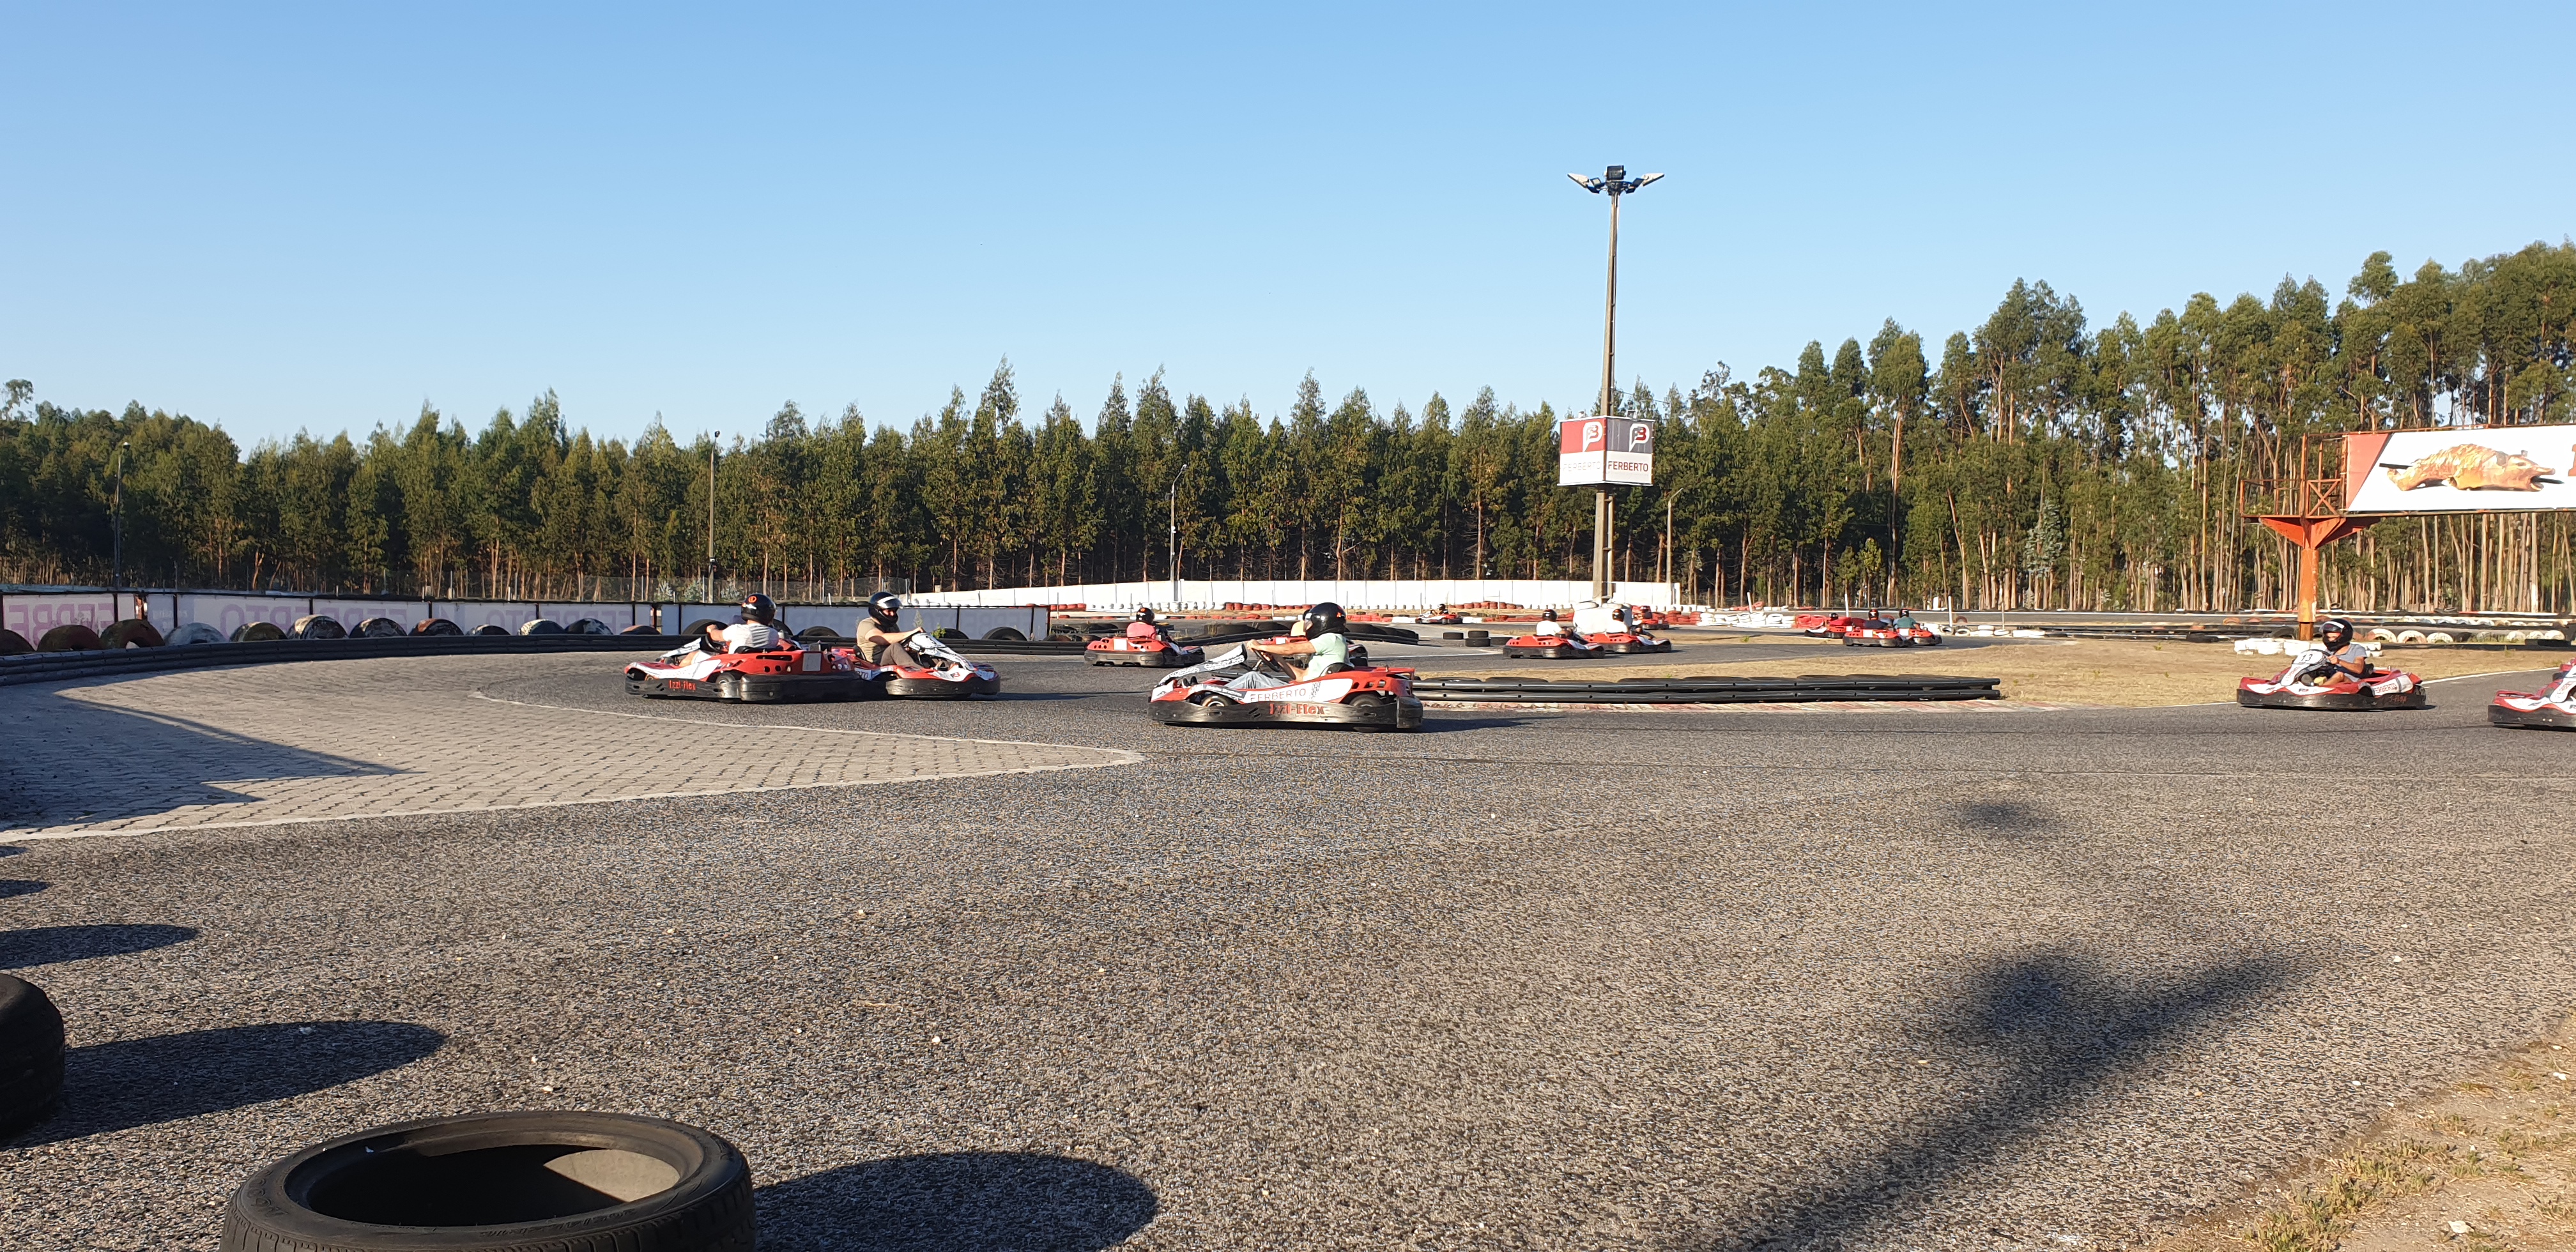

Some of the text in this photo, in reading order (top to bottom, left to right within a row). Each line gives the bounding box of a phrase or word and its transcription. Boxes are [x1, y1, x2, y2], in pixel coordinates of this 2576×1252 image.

[1607, 461, 1648, 472] FERBERTO
[2301, 653, 2313, 662] 13
[1250, 688, 1307, 701] FERBERTO
